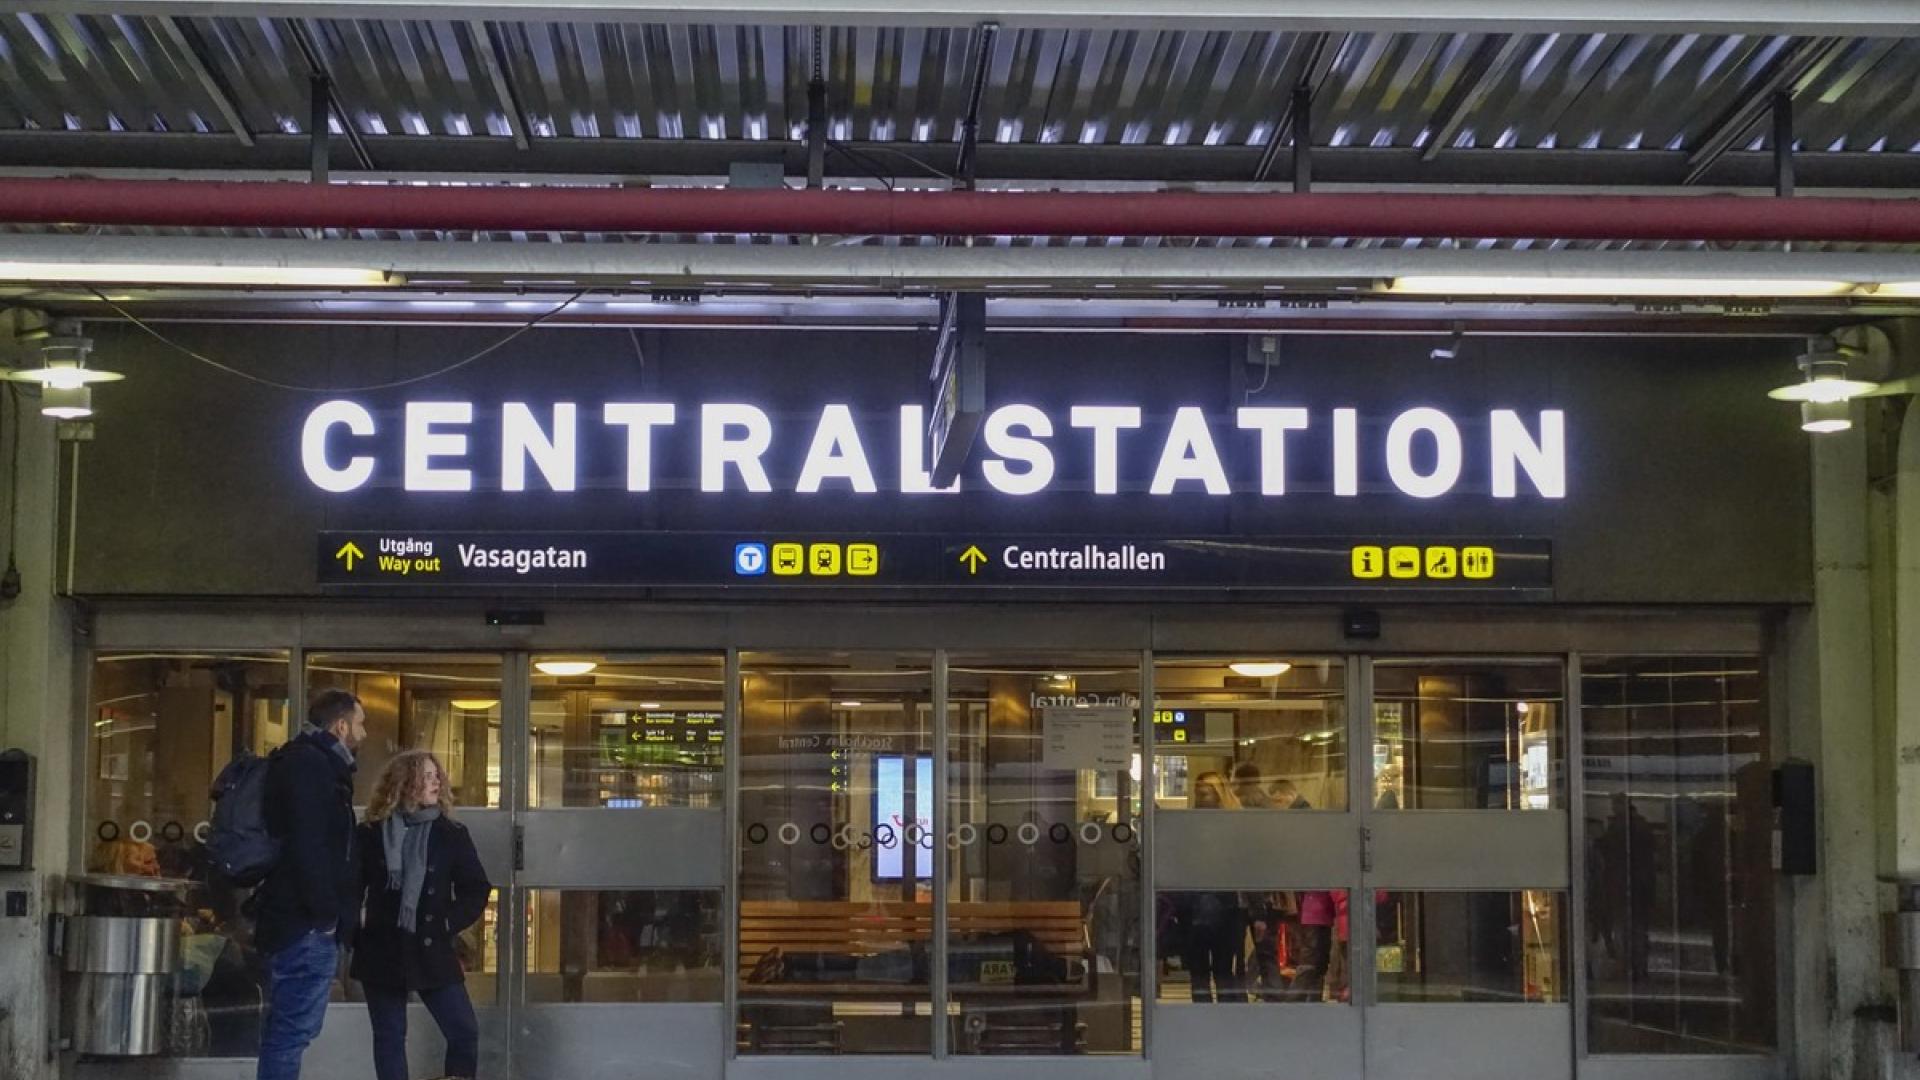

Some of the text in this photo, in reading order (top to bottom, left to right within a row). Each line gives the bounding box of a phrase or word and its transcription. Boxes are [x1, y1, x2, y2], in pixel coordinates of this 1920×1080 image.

[380, 537, 433, 556] Utgång
[1003, 544, 1165, 570] Centralhallen
[379, 556, 441, 575] Way out
[458, 544, 587, 573] Vasagatan
